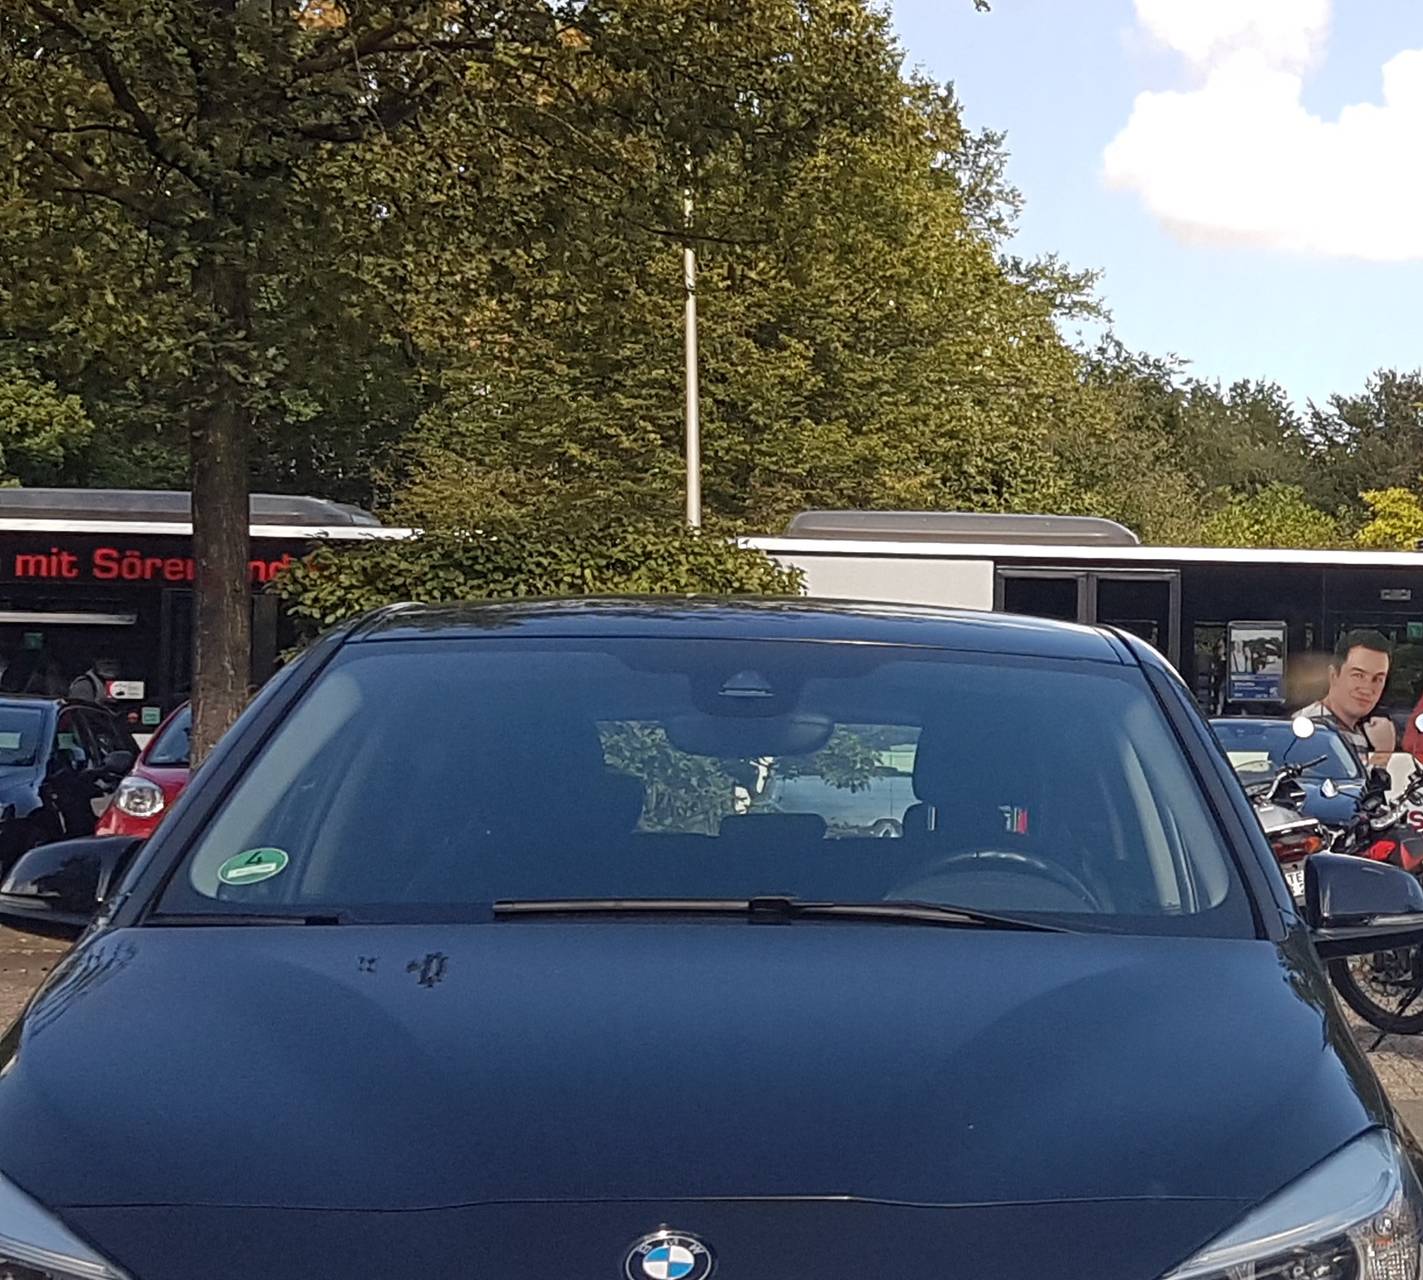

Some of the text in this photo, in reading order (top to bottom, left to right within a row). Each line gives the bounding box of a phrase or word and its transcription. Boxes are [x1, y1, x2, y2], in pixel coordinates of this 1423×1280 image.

[15, 547, 79, 578] mit
[244, 851, 264, 866] 4
[634, 1237, 706, 1256] BMW
